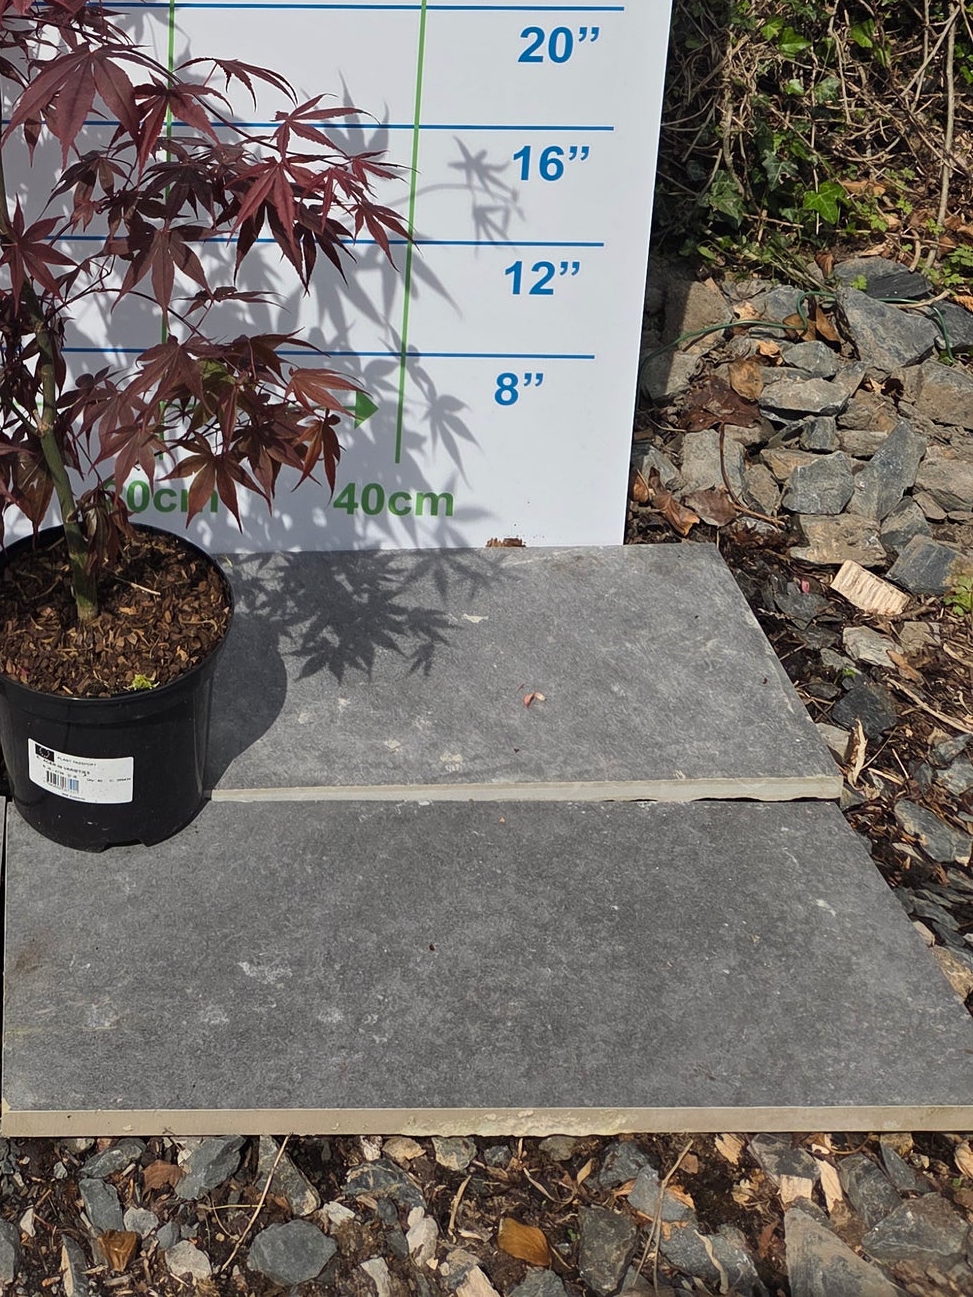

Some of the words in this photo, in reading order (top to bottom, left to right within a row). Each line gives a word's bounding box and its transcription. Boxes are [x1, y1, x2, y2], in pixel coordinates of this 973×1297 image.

[518, 27, 599, 63] 20”
[513, 146, 589, 181] 16”
[505, 261, 579, 295] 12”
[494, 372, 544, 406] 8”
[333, 482, 455, 517] 40cm
